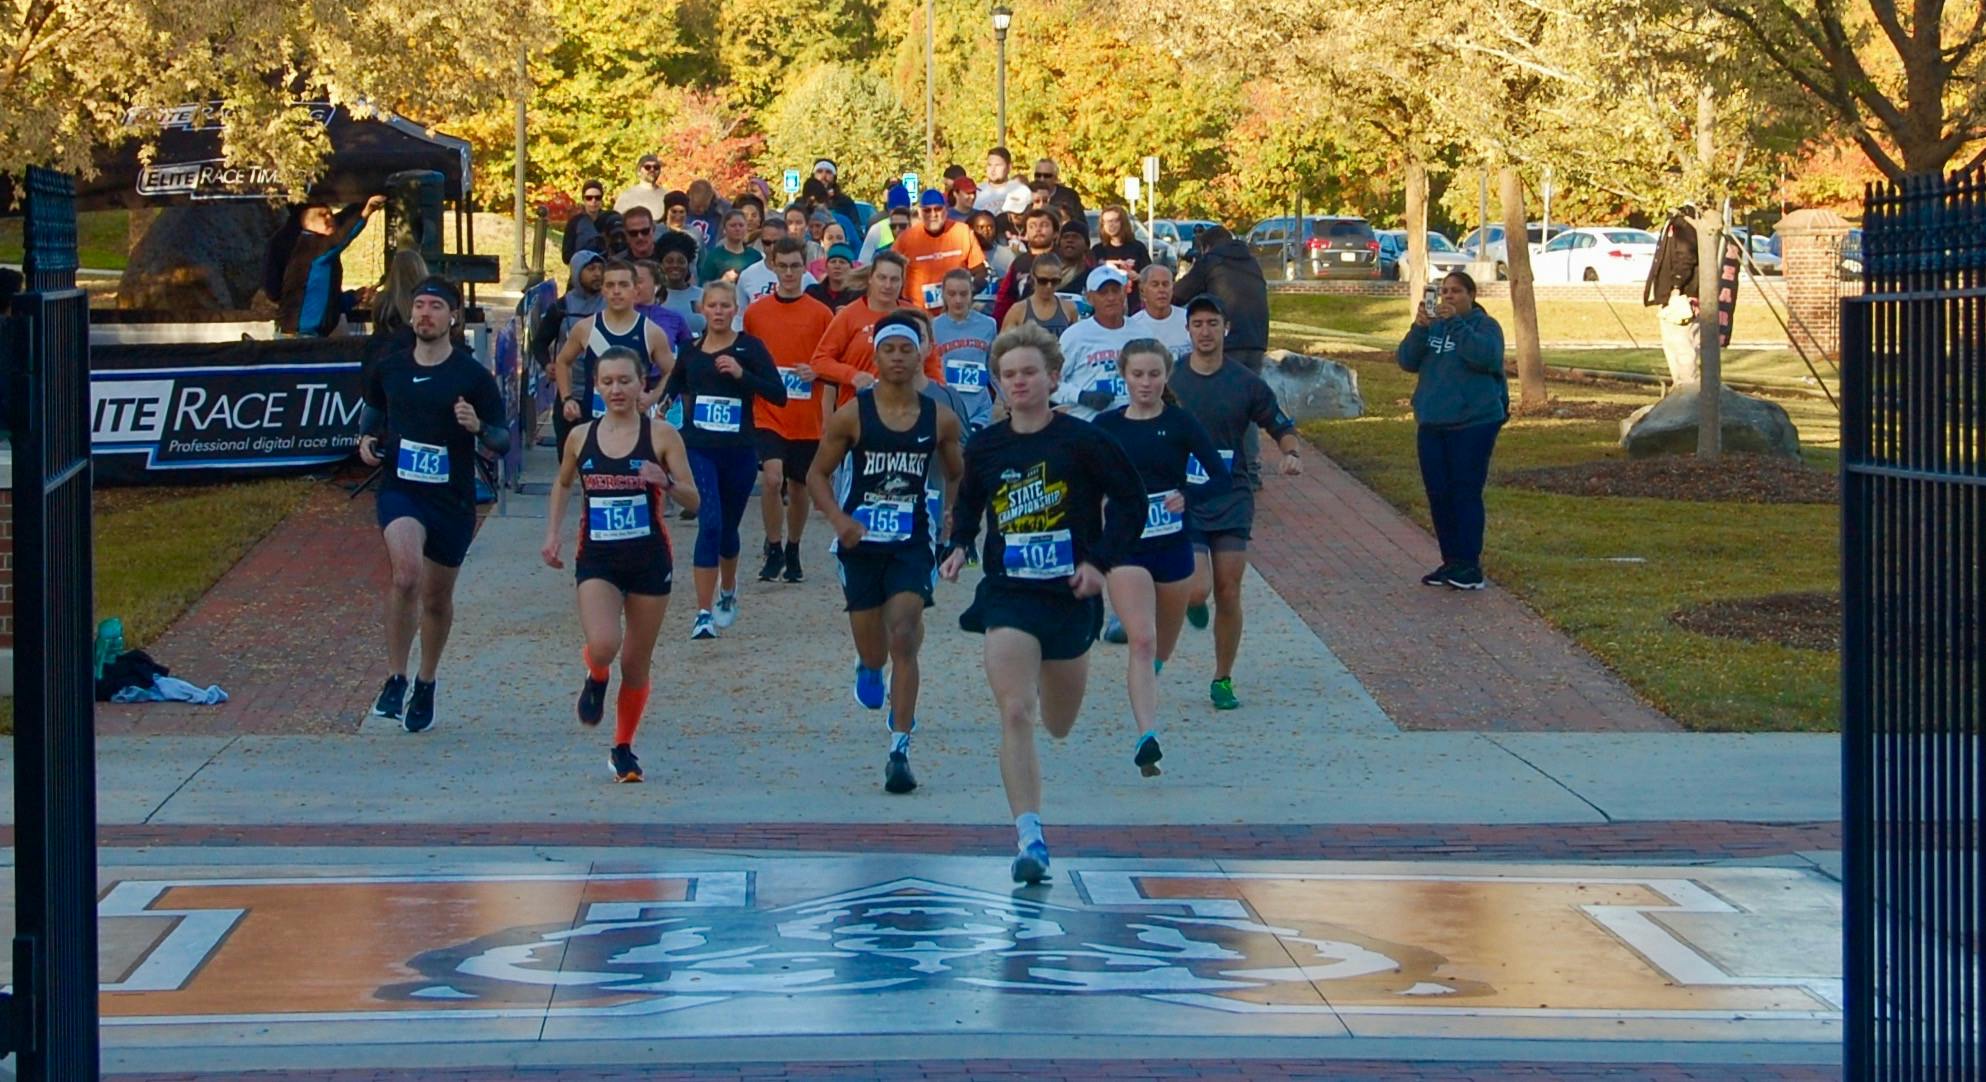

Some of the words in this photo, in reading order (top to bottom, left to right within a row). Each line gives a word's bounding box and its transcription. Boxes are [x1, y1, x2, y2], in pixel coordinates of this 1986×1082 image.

[149, 171, 195, 187] ELITE
[200, 167, 245, 185] RACE
[249, 165, 281, 185] TIM
[957, 367, 980, 386] 123
[93, 397, 159, 433] ITE
[173, 386, 288, 432] RACE
[296, 382, 363, 427] TIM
[706, 403, 731, 424] 165
[169, 438, 249, 452] Professional
[253, 436, 295, 454] digital
[298, 438, 327, 449] race
[411, 452, 440, 475] 143
[863, 450, 928, 477] HOWARD
[1007, 479, 1044, 508] STATE
[603, 506, 637, 531] 154
[999, 489, 1061, 524] CHAMPIONSHIP
[1149, 501, 1171, 527] 05
[869, 509, 901, 533] 155
[1019, 542, 1059, 570] 104
